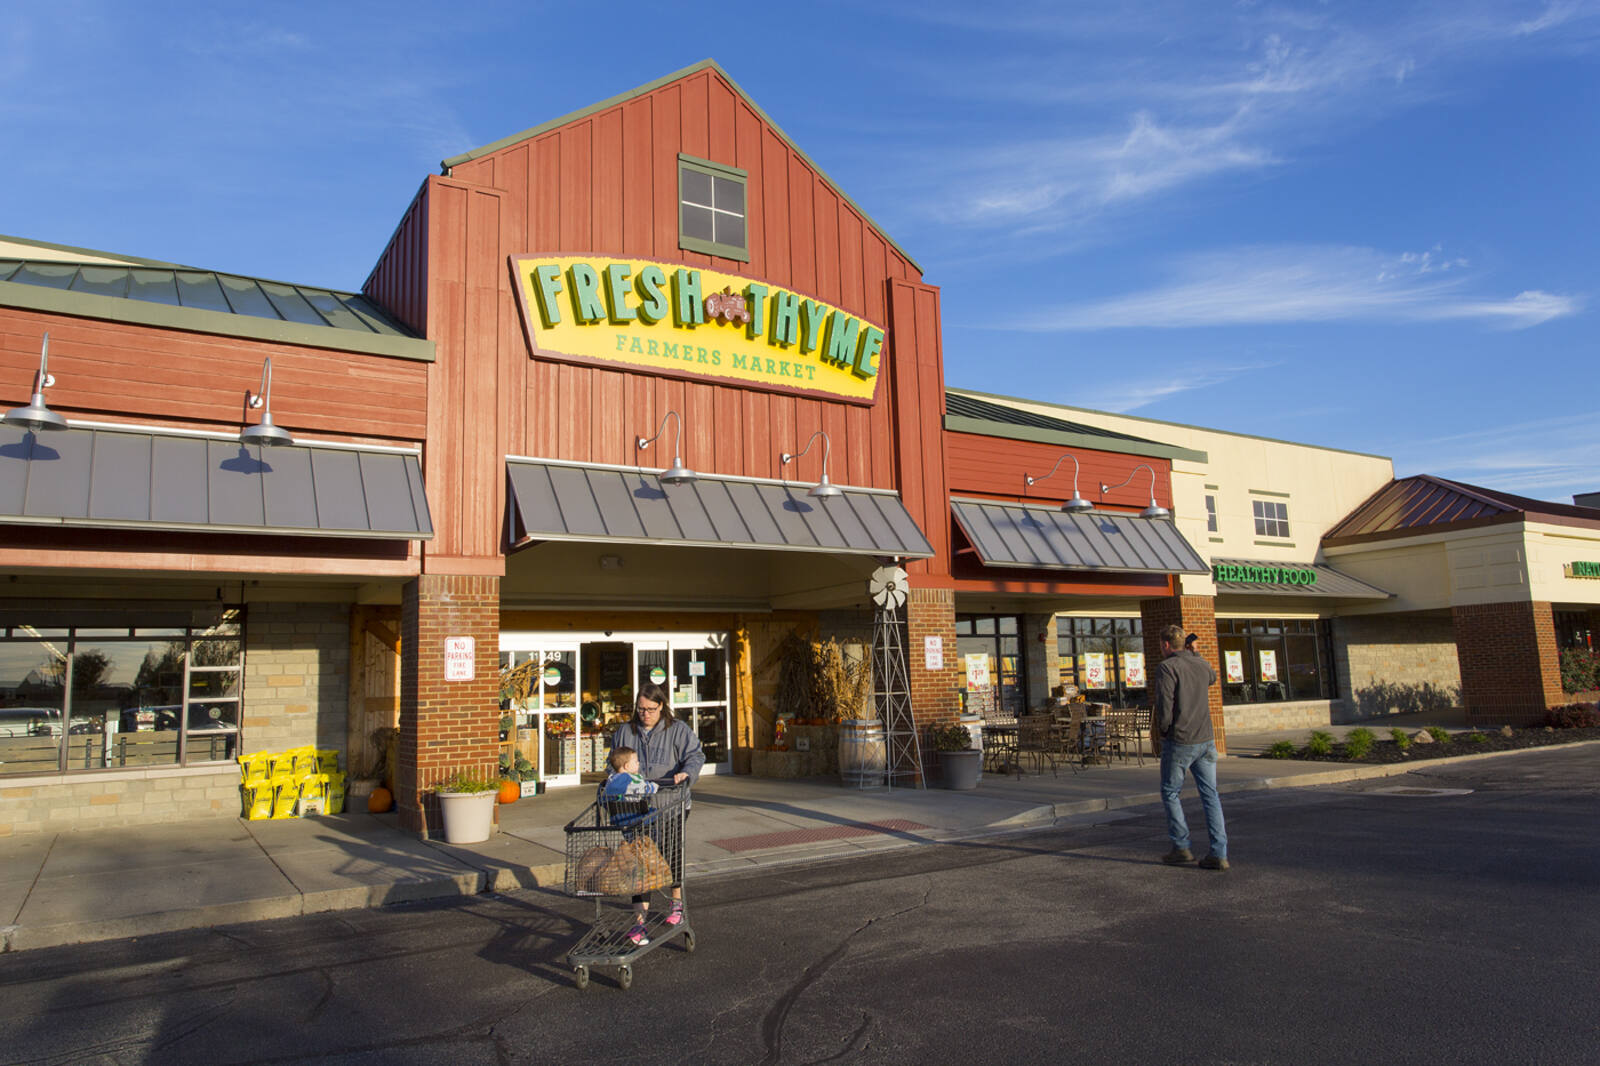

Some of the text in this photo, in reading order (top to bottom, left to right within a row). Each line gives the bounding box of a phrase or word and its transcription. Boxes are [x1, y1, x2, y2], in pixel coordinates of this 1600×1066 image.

[531, 263, 885, 380] FRESH THYME
[615, 334, 817, 380] FARMERS MARKET
[1215, 565, 1318, 585] HEALTHY FOOD
[454, 641, 466, 650] NO
[447, 651, 472, 660] PARKING
[528, 651, 562, 662] 1149
